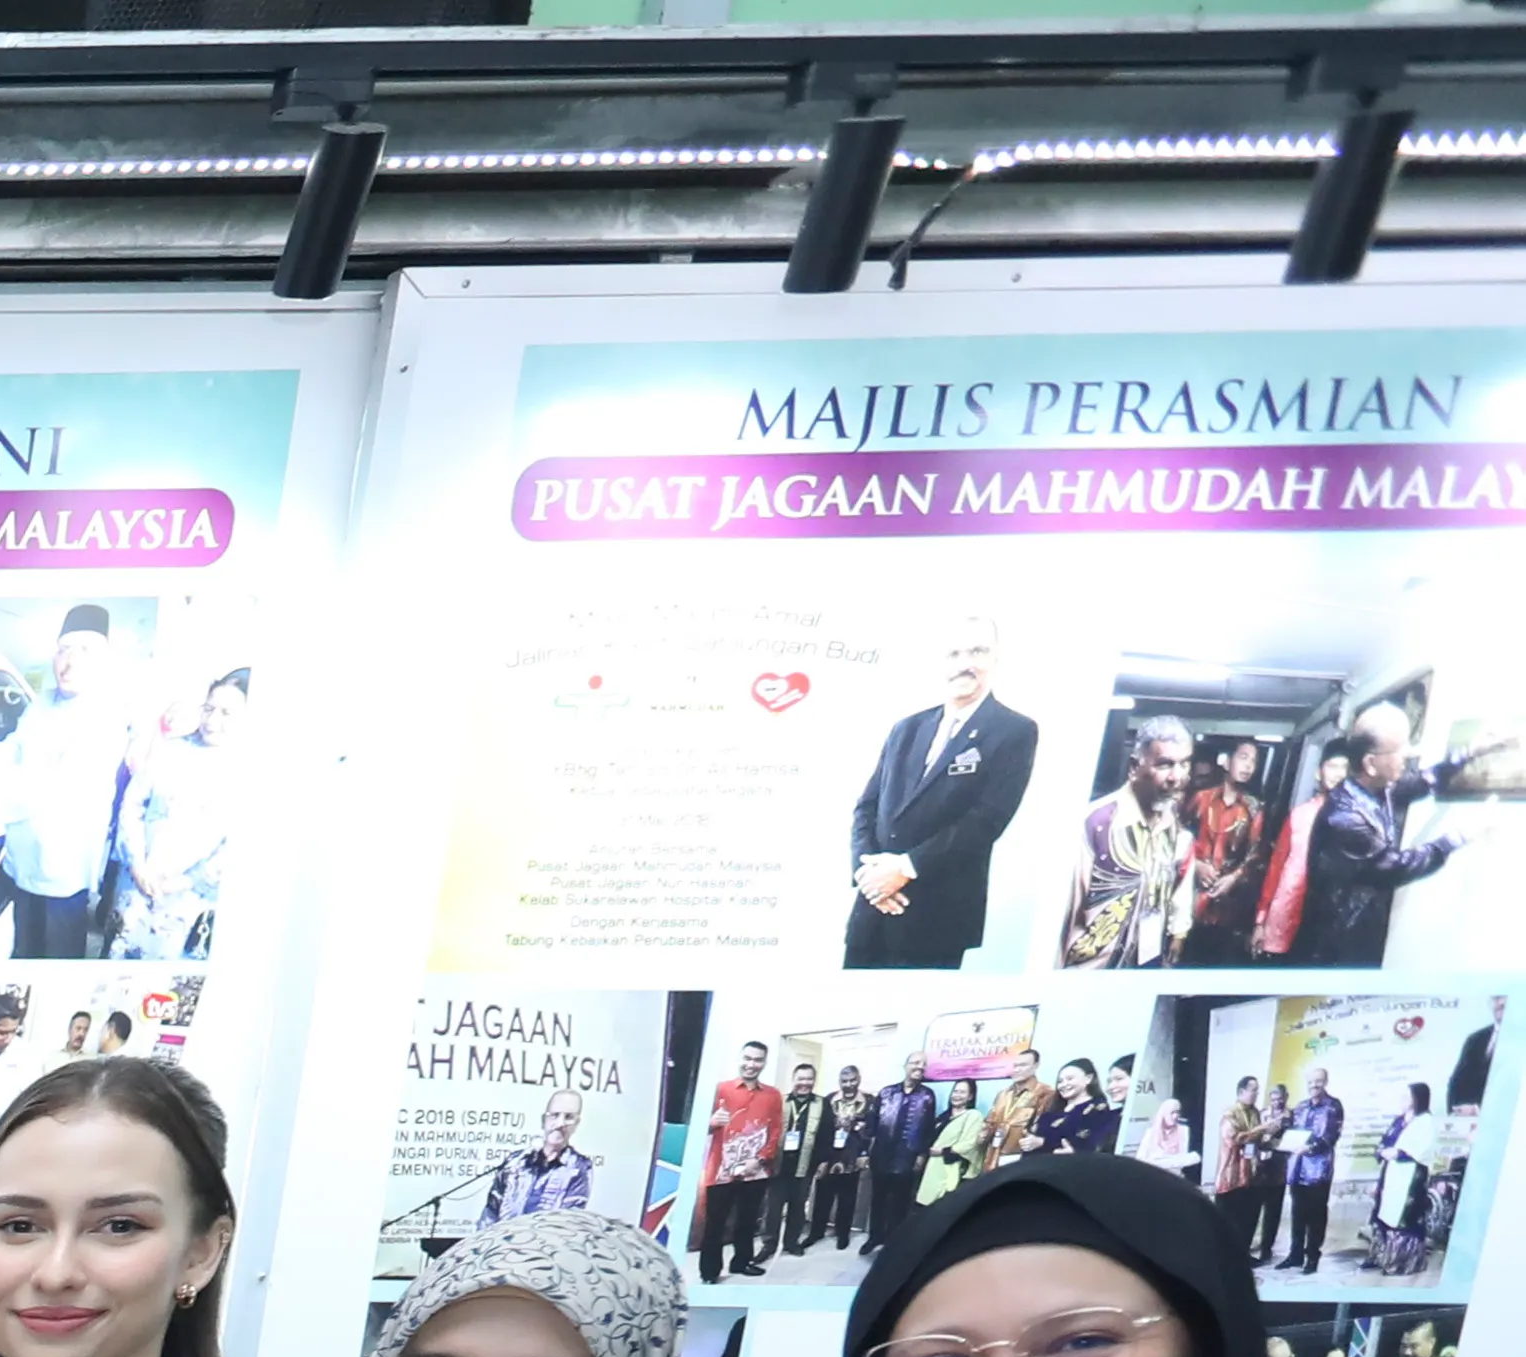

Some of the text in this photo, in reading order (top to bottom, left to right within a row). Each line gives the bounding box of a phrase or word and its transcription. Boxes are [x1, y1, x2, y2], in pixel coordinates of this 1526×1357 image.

[737, 374, 1463, 454] MAJLIS PERASMIAN
[529, 475, 705, 522] PUSAT
[711, 473, 942, 531] JAGAAN
[949, 465, 1328, 514] MAHMUDAH
[825, 639, 883, 666] Budi
[527, 859, 569, 873] Pusat
[718, 859, 782, 876] Malaysia
[549, 876, 593, 890] Pusat
[518, 893, 560, 907] Kelab
[663, 893, 724, 909] Hospital
[570, 915, 625, 931] Dengan
[504, 933, 555, 949] Tabung
[716, 933, 780, 950] Malaysia
[432, 998, 573, 1048] JAGAAN
[465, 1044, 624, 1094] MALAYSIA
[414, 1109, 456, 1125] 2018
[461, 1109, 526, 1130] (SABTU)
[413, 1130, 493, 1144] MAHMUDAH
[388, 1163, 454, 1178] EMENYIH,
